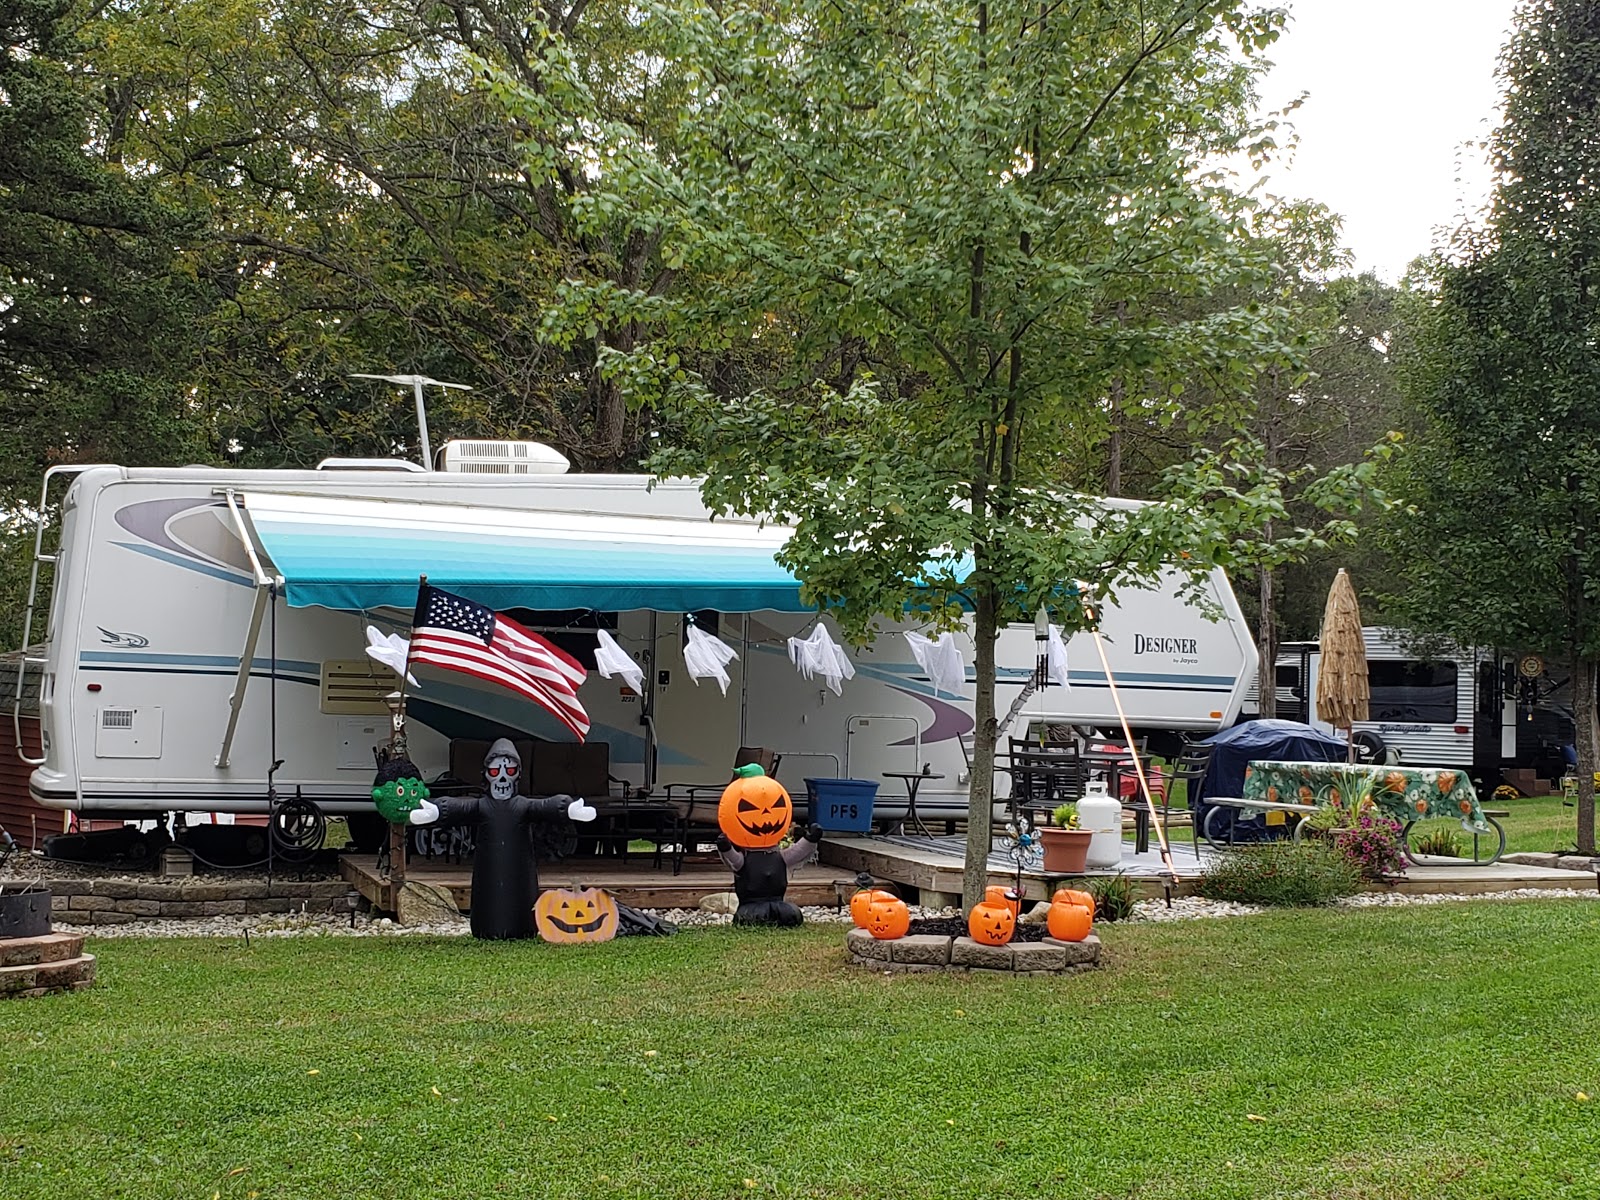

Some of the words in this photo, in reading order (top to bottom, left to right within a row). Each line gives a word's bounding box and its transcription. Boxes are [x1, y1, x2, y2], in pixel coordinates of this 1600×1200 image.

[1133, 633, 1198, 655] DESIGNER
[1180, 657, 1198, 665] Jayco
[830, 804, 858, 819] PFS
